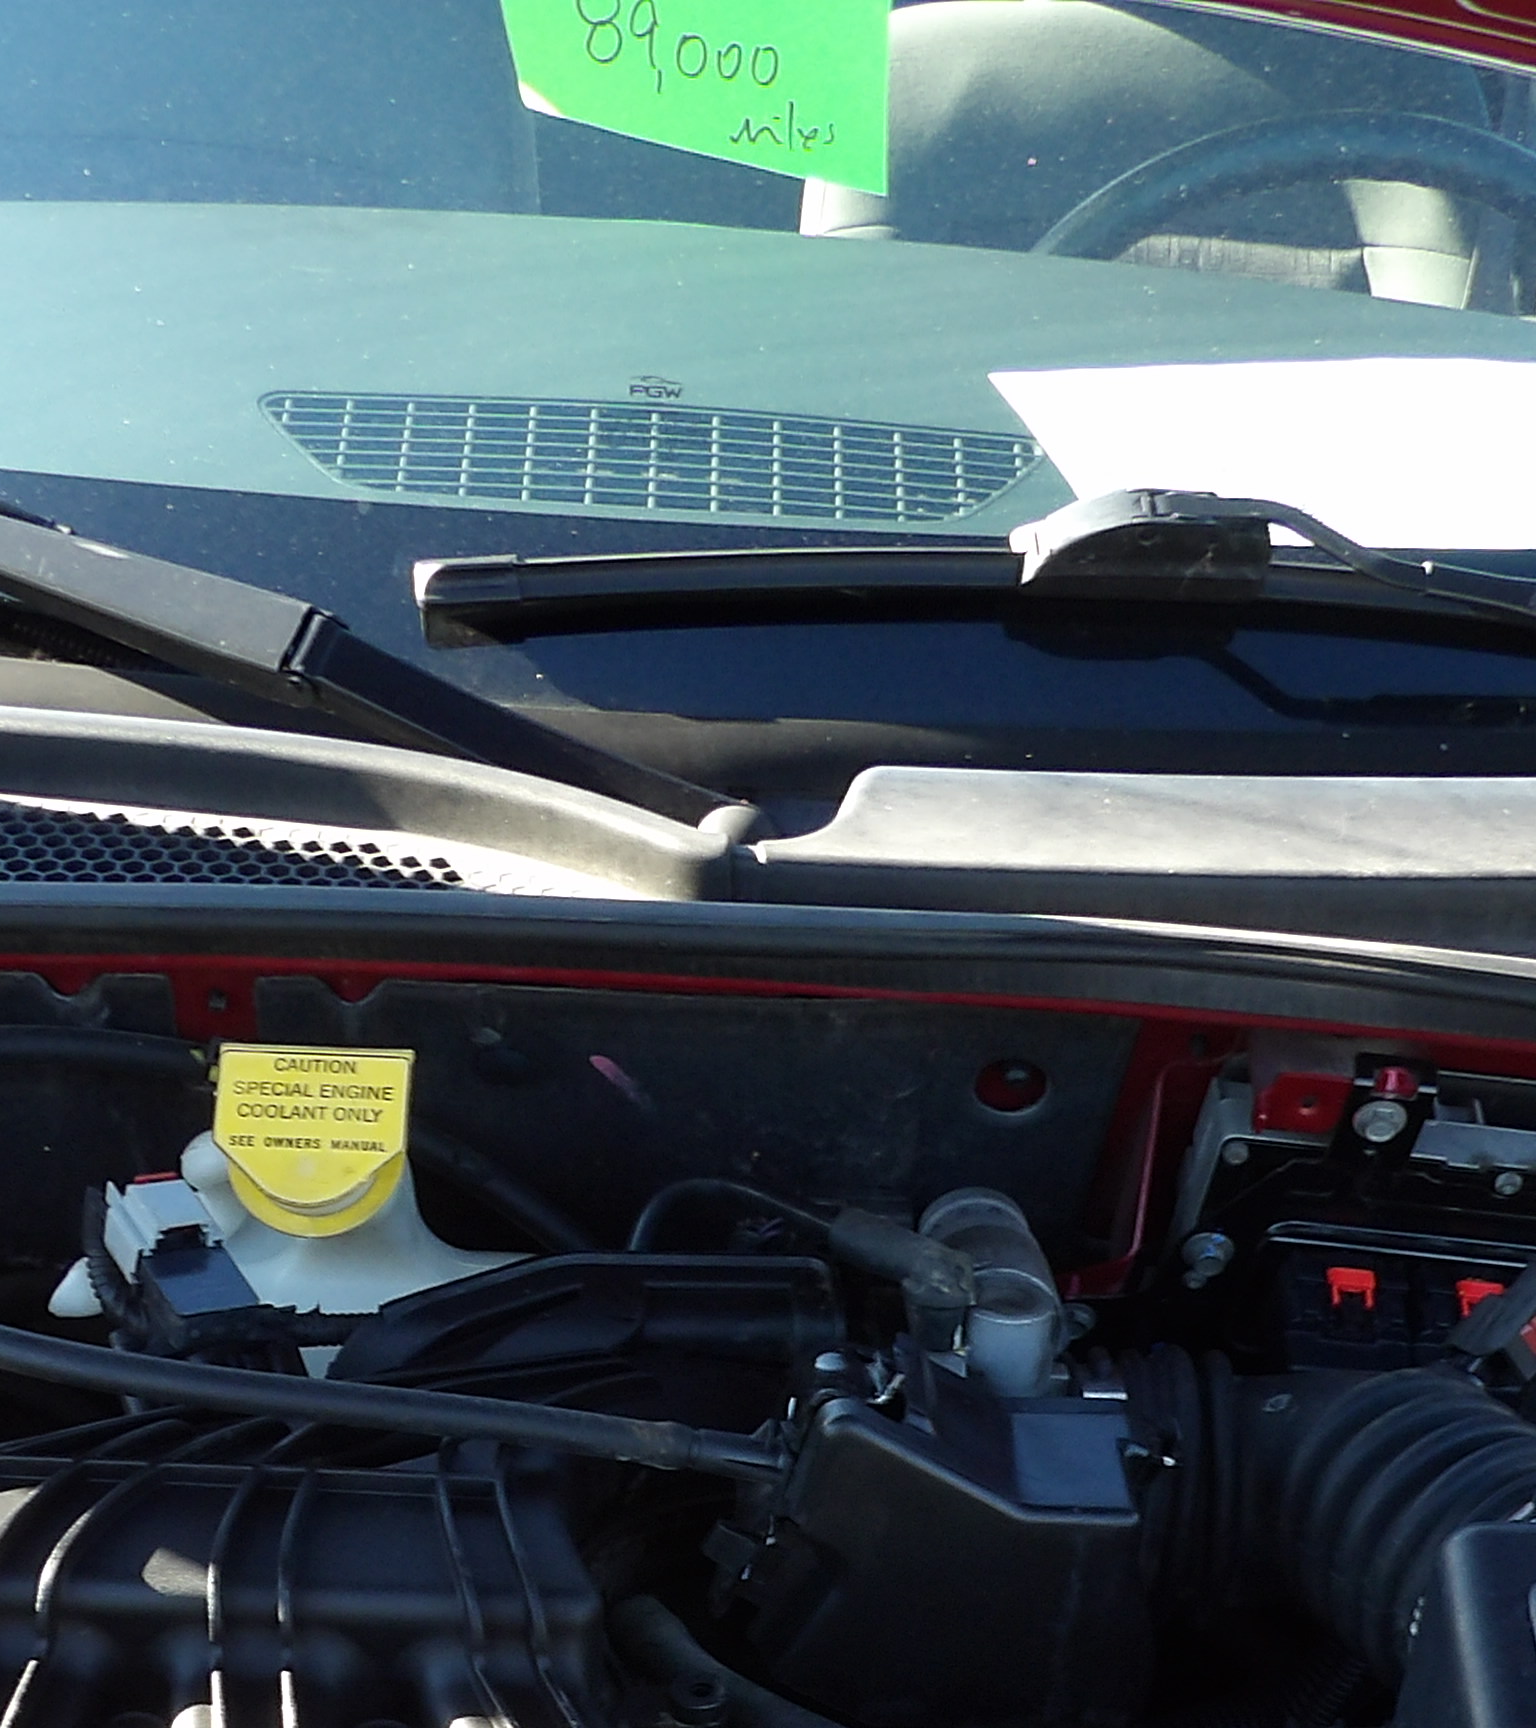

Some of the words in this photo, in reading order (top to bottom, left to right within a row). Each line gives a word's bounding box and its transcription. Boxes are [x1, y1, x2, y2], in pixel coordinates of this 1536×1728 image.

[576, 0, 779, 94] 89,000
[629, 384, 683, 399] PGW
[273, 1057, 357, 1075] CAUTION
[232, 1080, 314, 1098] SPECIAL
[319, 1083, 395, 1101] ENGINE
[236, 1102, 329, 1120] COOLANT
[332, 1106, 384, 1123] ONLY
[228, 1135, 256, 1147] SEE
[264, 1136, 321, 1149] OWNERS
